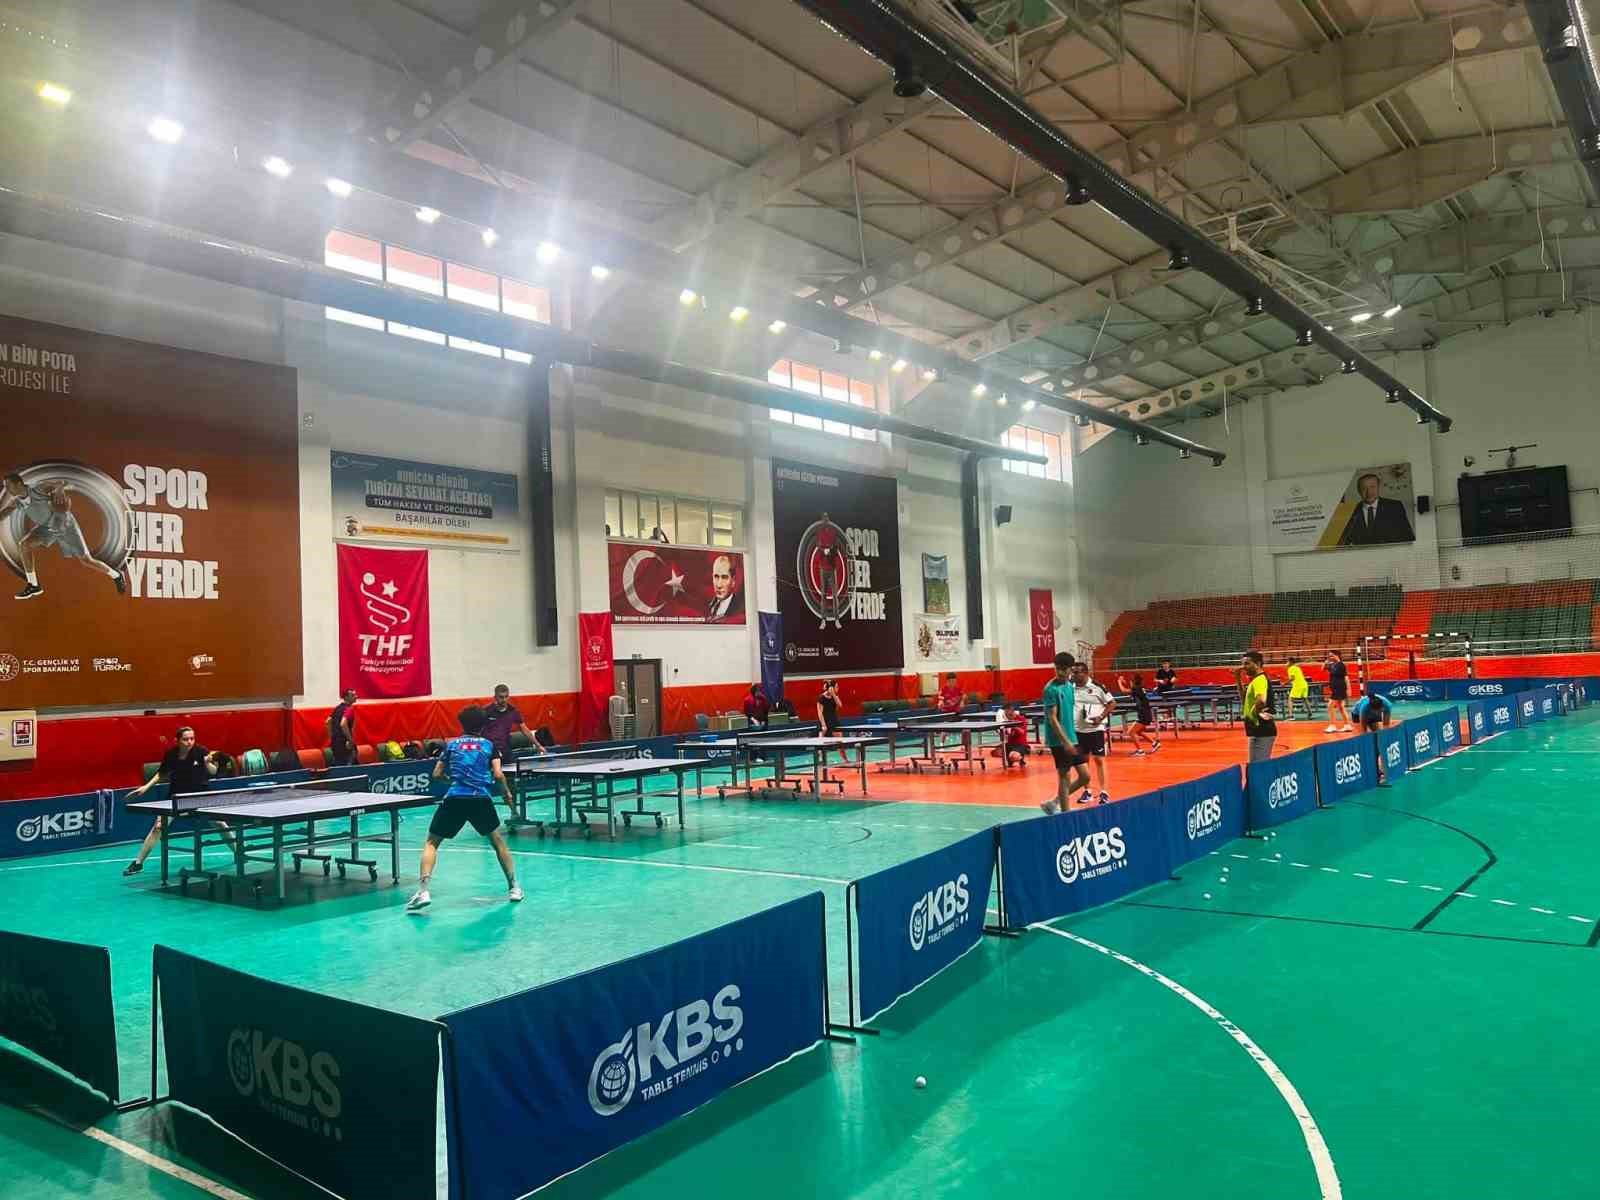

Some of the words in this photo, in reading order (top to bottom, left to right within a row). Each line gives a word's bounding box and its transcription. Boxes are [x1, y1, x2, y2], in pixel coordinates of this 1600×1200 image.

[12, 344, 38, 366] BİN
[41, 350, 77, 372] POTA
[123, 463, 209, 511] SPOR
[124, 510, 185, 553] HER
[846, 527, 880, 557] SPOR
[126, 557, 219, 600] YERDE
[848, 592, 887, 620] YERDE
[358, 634, 413, 656] THF
[1035, 634, 1053, 648] TVF
[1399, 685, 1424, 694] KBS
[1478, 684, 1503, 693] KBS
[1342, 753, 1361, 778] KBS
[388, 773, 431, 794] KBS
[1277, 772, 1298, 800] KBS
[41, 808, 95, 835] KBS
[1196, 794, 1221, 829] KBS
[1075, 826, 1126, 870] KBS
[928, 873, 969, 931] KBS
[637, 984, 744, 1083] KBS
[253, 1029, 342, 1118] KBS
[641, 1077, 674, 1101] TABLE
[673, 1057, 709, 1085] TENNIS
